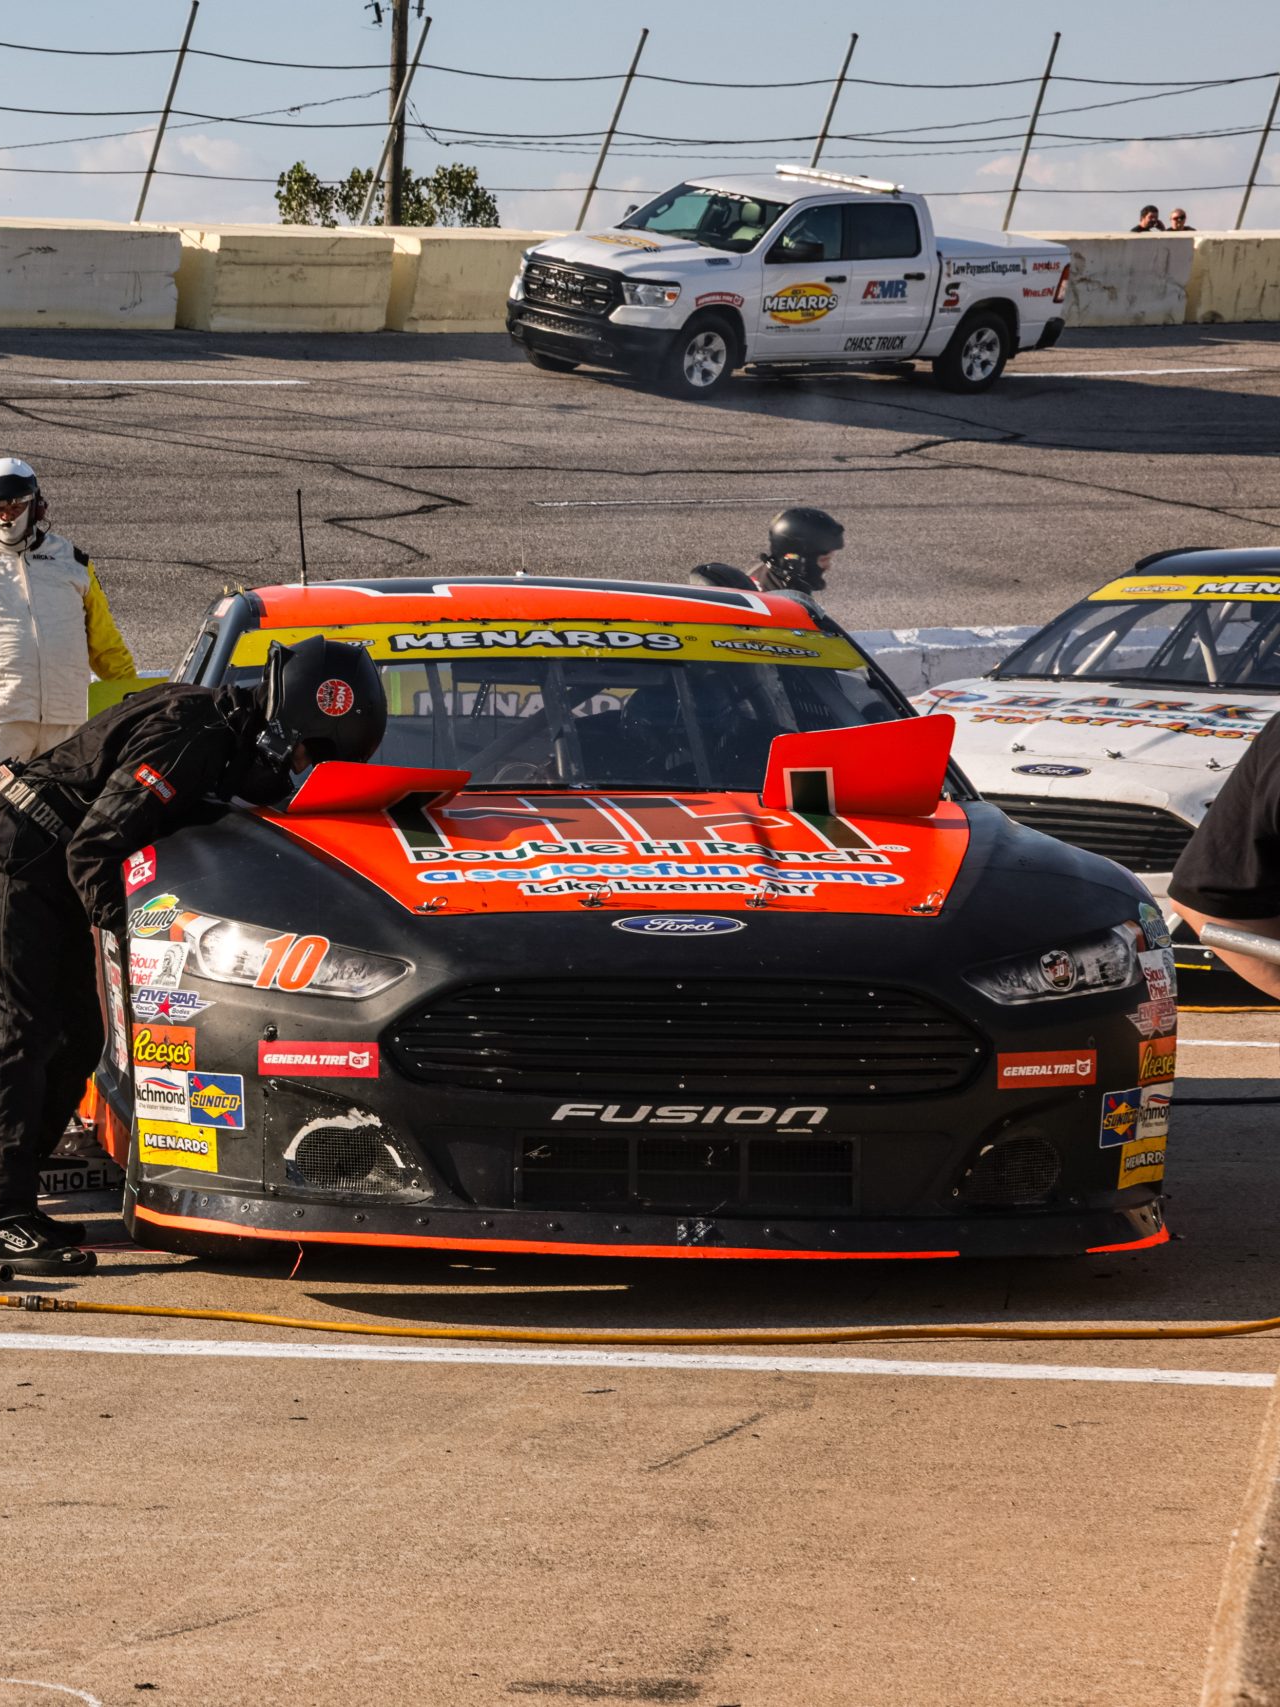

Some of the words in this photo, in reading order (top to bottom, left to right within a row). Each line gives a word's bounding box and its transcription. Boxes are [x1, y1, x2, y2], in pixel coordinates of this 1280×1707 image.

[862, 280, 908, 299] AMR
[763, 295, 838, 312] MENARDS
[844, 337, 874, 351] CHASE
[875, 335, 907, 350] TRUCK
[391, 629, 684, 653] MENARDS
[711, 640, 821, 658] MENARDS
[335, 686, 346, 710] NGK
[1029, 765, 1072, 775] Ford
[414, 841, 626, 863] Double
[644, 842, 683, 854] H
[704, 843, 884, 864] Ranch
[424, 871, 457, 882] a
[752, 864, 899, 885] camp
[767, 884, 809, 897] NY
[129, 906, 182, 933] Bounty
[644, 917, 718, 932] Ford
[130, 953, 159, 969] Sioux
[254, 933, 329, 992] 10
[130, 971, 153, 986] hief
[1144, 967, 1166, 982] Sioux
[139, 990, 168, 1002] FIVE
[170, 991, 197, 1007] STAR
[133, 1028, 192, 1065] Reese's
[263, 1053, 318, 1065] GENERAL
[319, 1055, 349, 1065] TIRE
[1140, 1046, 1176, 1080] Reese
[1003, 1065, 1052, 1077] GENERAL
[1053, 1064, 1076, 1075] TIRE
[192, 1094, 238, 1109] SUNOCO
[551, 1103, 829, 1125] FUSION
[145, 1133, 208, 1154] MENARDS
[1124, 1151, 1165, 1171] MENARDS
